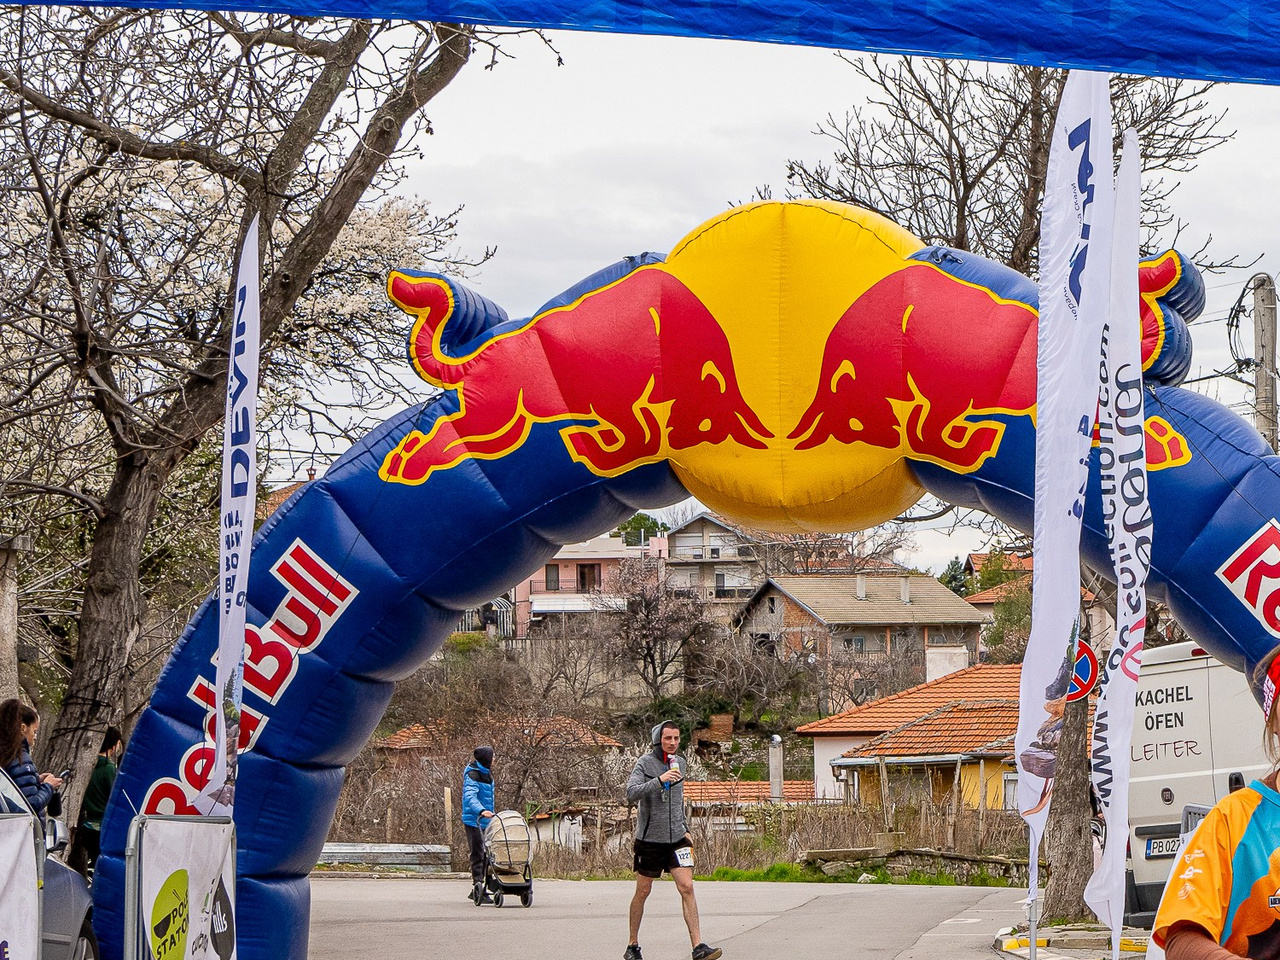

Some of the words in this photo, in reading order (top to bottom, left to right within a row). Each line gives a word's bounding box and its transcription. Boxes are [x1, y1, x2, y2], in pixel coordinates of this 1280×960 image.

[230, 284, 251, 498] DEVIN
[242, 543, 352, 701] Bull
[1135, 685, 1194, 706] KACHEL
[1145, 711, 1185, 731] ÖFEN
[1130, 740, 1202, 762] LEITER
[1152, 841, 1164, 853] PB
